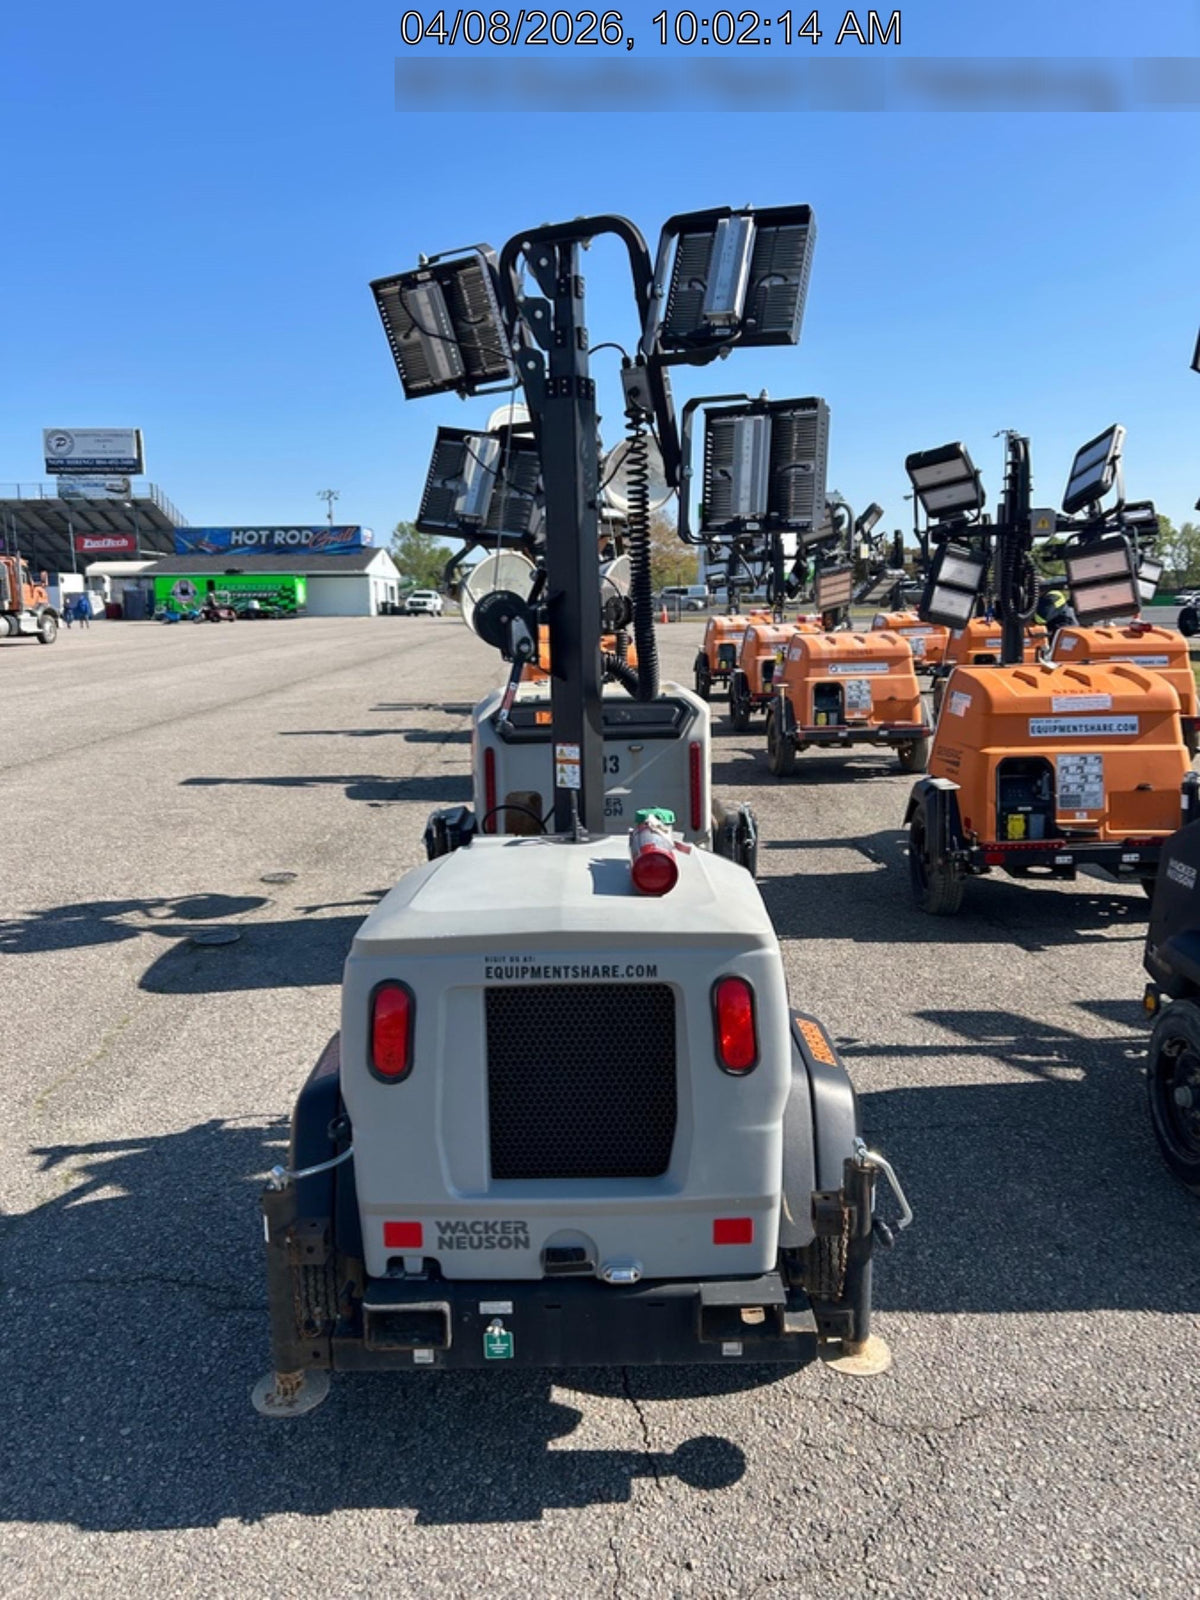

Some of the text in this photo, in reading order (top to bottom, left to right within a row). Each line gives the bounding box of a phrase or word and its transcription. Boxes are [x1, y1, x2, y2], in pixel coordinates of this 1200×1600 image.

[231, 530, 270, 545] HOT
[274, 530, 313, 545] ROD
[1031, 723, 1137, 734] EQUIPMENTSHARE.COM
[485, 965, 658, 979] EQUIPMENTSHARE.COM
[435, 1221, 529, 1235] WACKER
[438, 1236, 530, 1250] NEUSON
